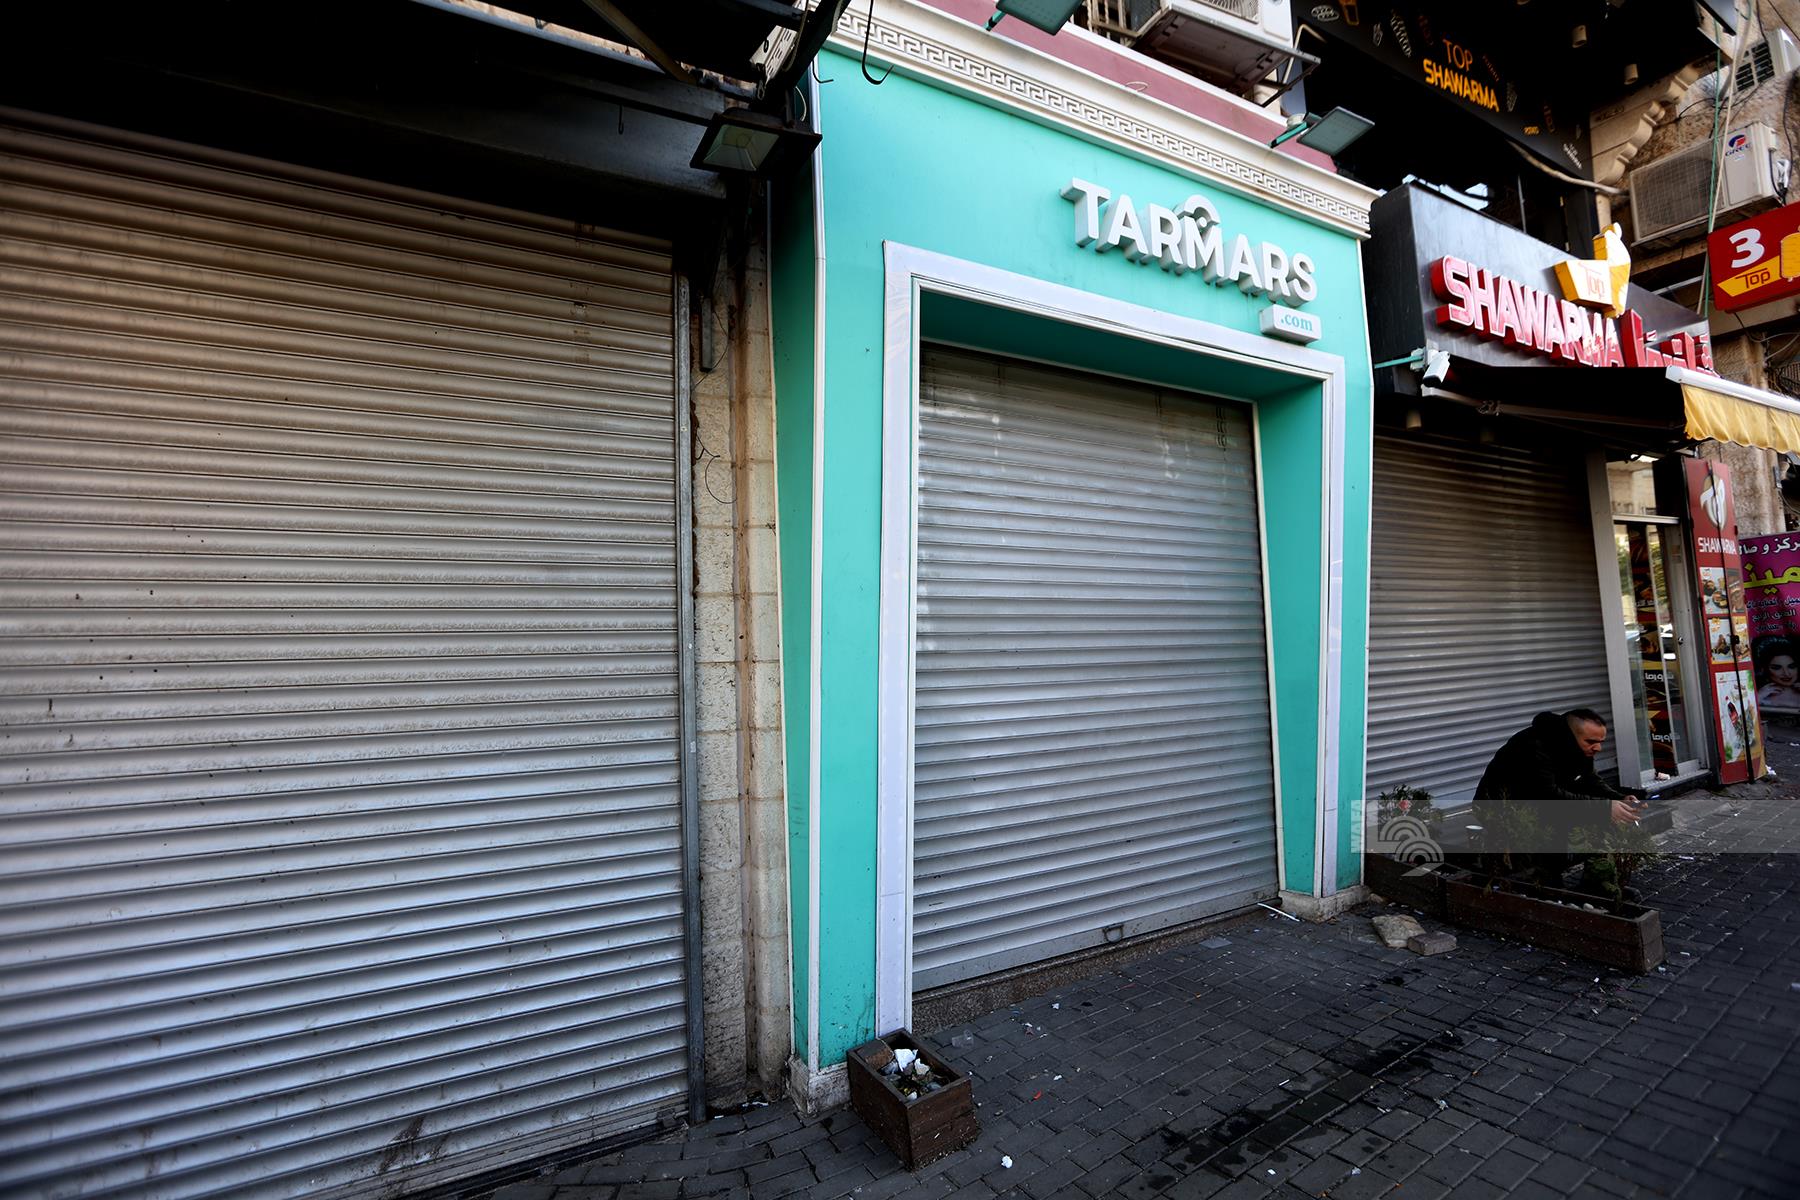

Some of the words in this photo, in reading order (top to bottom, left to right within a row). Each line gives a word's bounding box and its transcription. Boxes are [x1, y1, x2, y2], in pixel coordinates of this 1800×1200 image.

[1443, 38, 1474, 72] TOP
[1422, 57, 1501, 113] SHAWARMA
[1068, 176, 1319, 305] TARMARS
[1728, 227, 1766, 269] 3
[1577, 262, 1607, 300] Top
[1735, 266, 1772, 289] Top
[1280, 310, 1314, 332] .com
[1438, 253, 1626, 368] SHAWARMA
[1761, 543, 1770, 555] و
[1773, 537, 1800, 553] ركز
